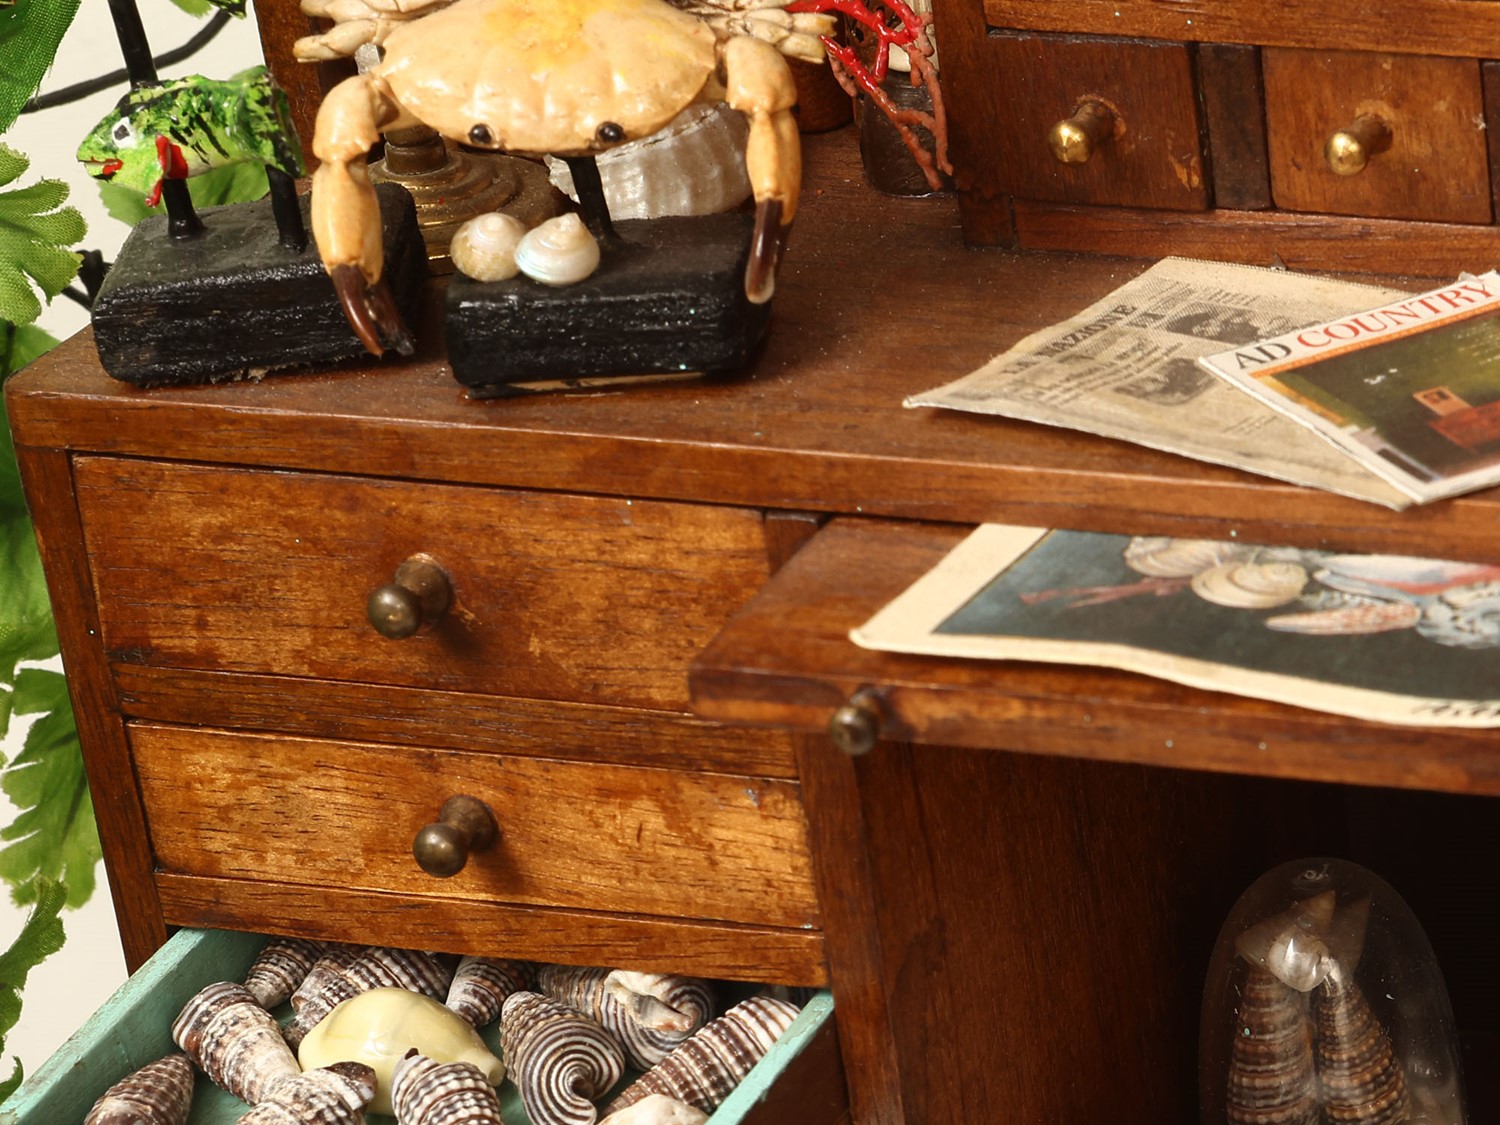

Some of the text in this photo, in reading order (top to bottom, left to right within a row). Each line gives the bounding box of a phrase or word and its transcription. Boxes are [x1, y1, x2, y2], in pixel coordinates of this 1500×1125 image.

[1034, 303, 1139, 358] NAZIONE
[1234, 342, 1293, 370] AD
[1297, 281, 1499, 349] COUNTRY
